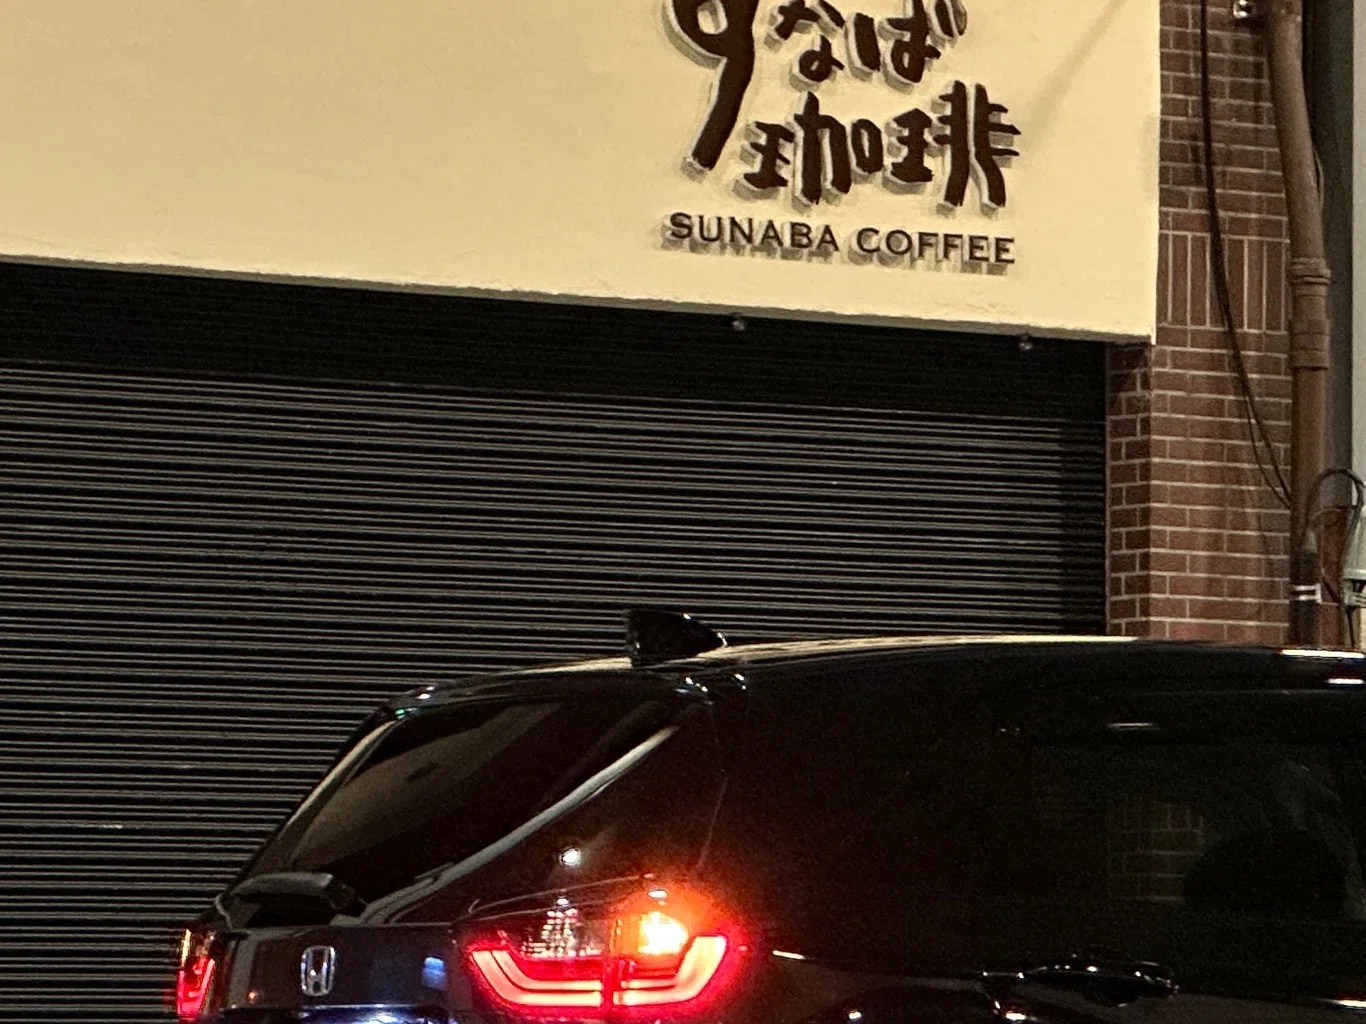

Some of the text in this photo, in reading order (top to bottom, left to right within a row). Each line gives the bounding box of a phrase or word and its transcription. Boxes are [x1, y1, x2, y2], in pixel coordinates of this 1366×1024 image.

[742, 80, 1021, 207] 珈琲
[669, 211, 1016, 265] SUNABA COFFEE
